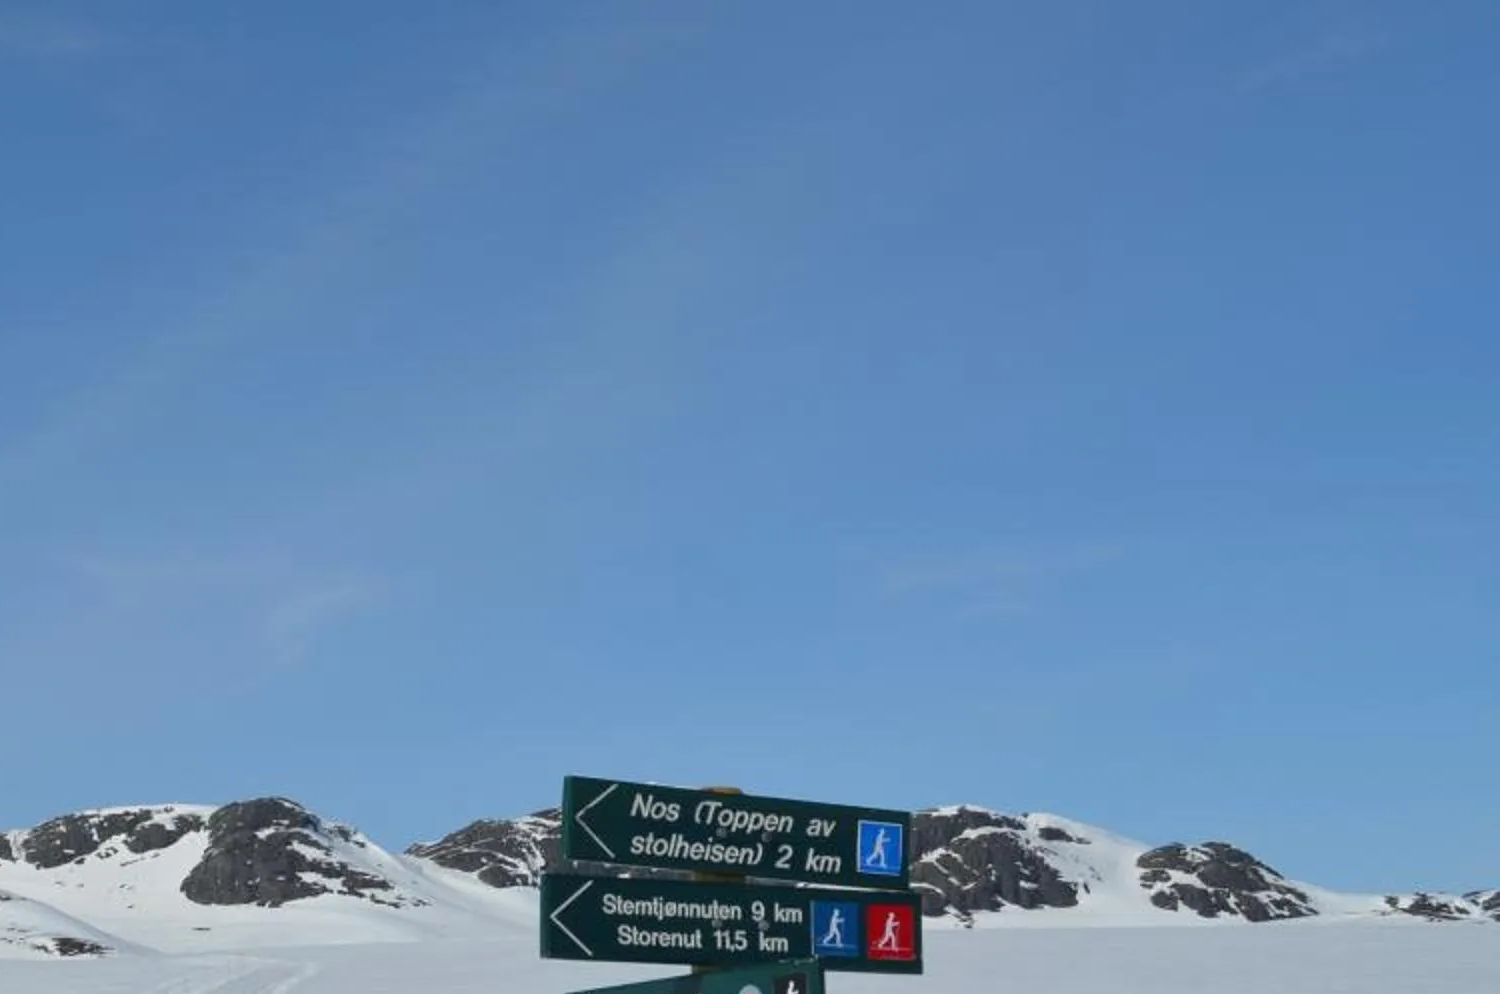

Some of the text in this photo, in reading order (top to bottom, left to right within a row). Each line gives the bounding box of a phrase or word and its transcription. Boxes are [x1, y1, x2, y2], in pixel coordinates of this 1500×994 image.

[630, 793, 836, 837] Nos (Toppen av
[630, 831, 841, 874] stolheisen) 2 km
[751, 902, 765, 922] 9
[774, 900, 803, 923] km
[617, 924, 789, 952] Storenut 11,5 km
